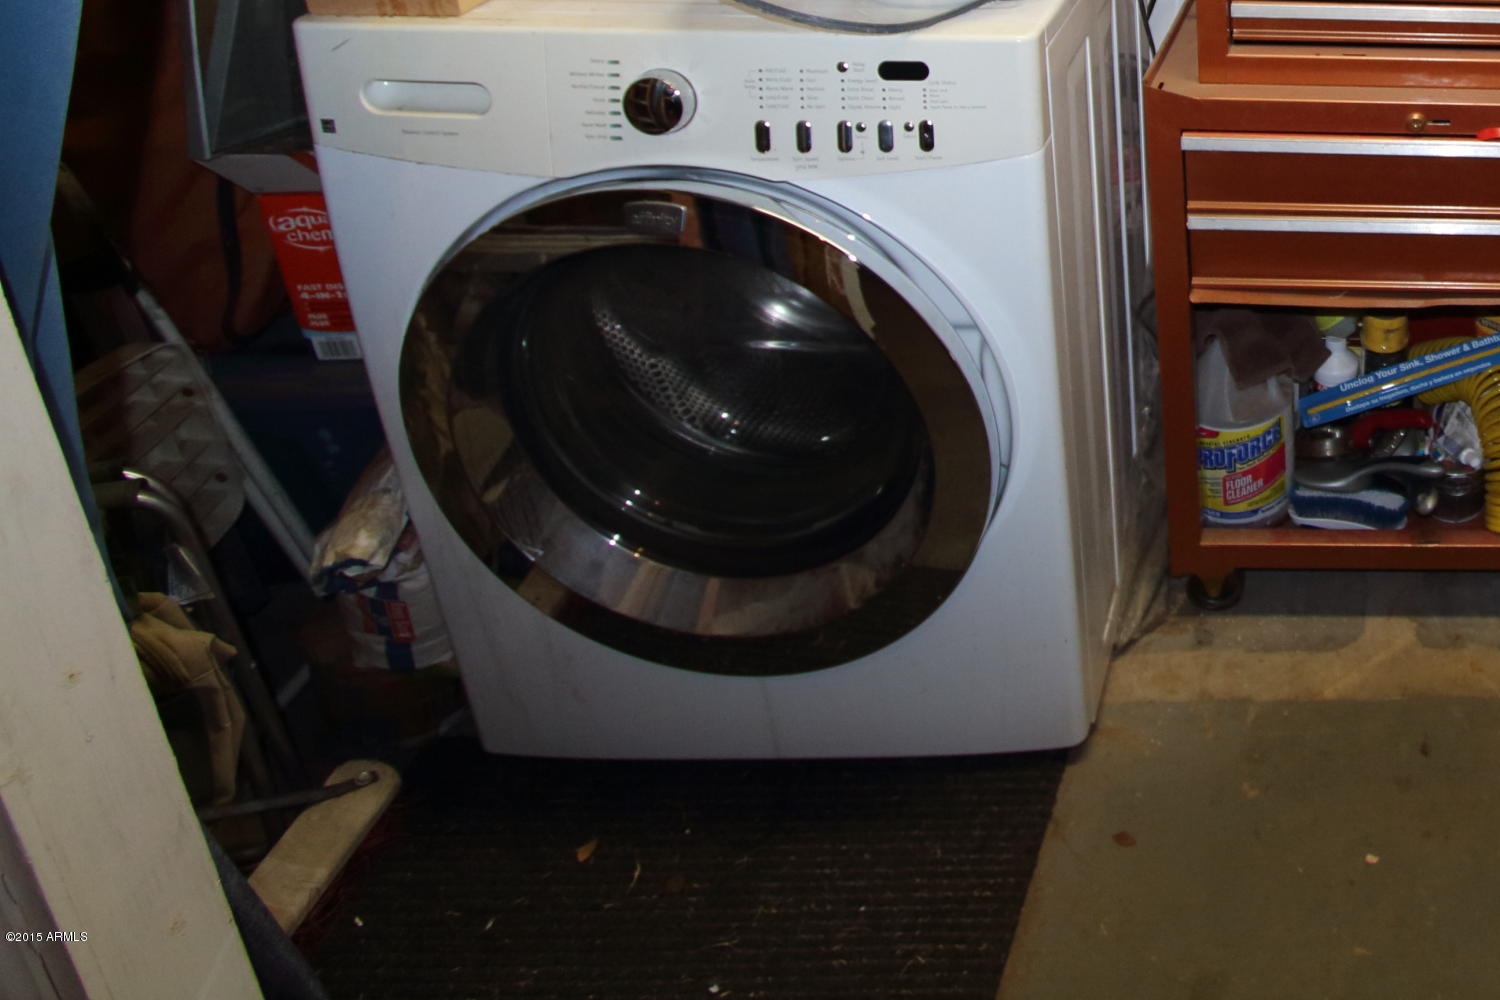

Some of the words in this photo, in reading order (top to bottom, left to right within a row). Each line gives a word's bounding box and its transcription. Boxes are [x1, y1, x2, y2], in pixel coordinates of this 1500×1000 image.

[1340, 375, 1374, 392] Unclog
[1376, 368, 1398, 379] Your
[1424, 348, 1461, 363] Shower
[1462, 342, 1470, 351] &
[1197, 422, 1281, 472] ROFORCE
[1226, 474, 1252, 491] FLOOR
[1227, 479, 1264, 500] CLEANER
